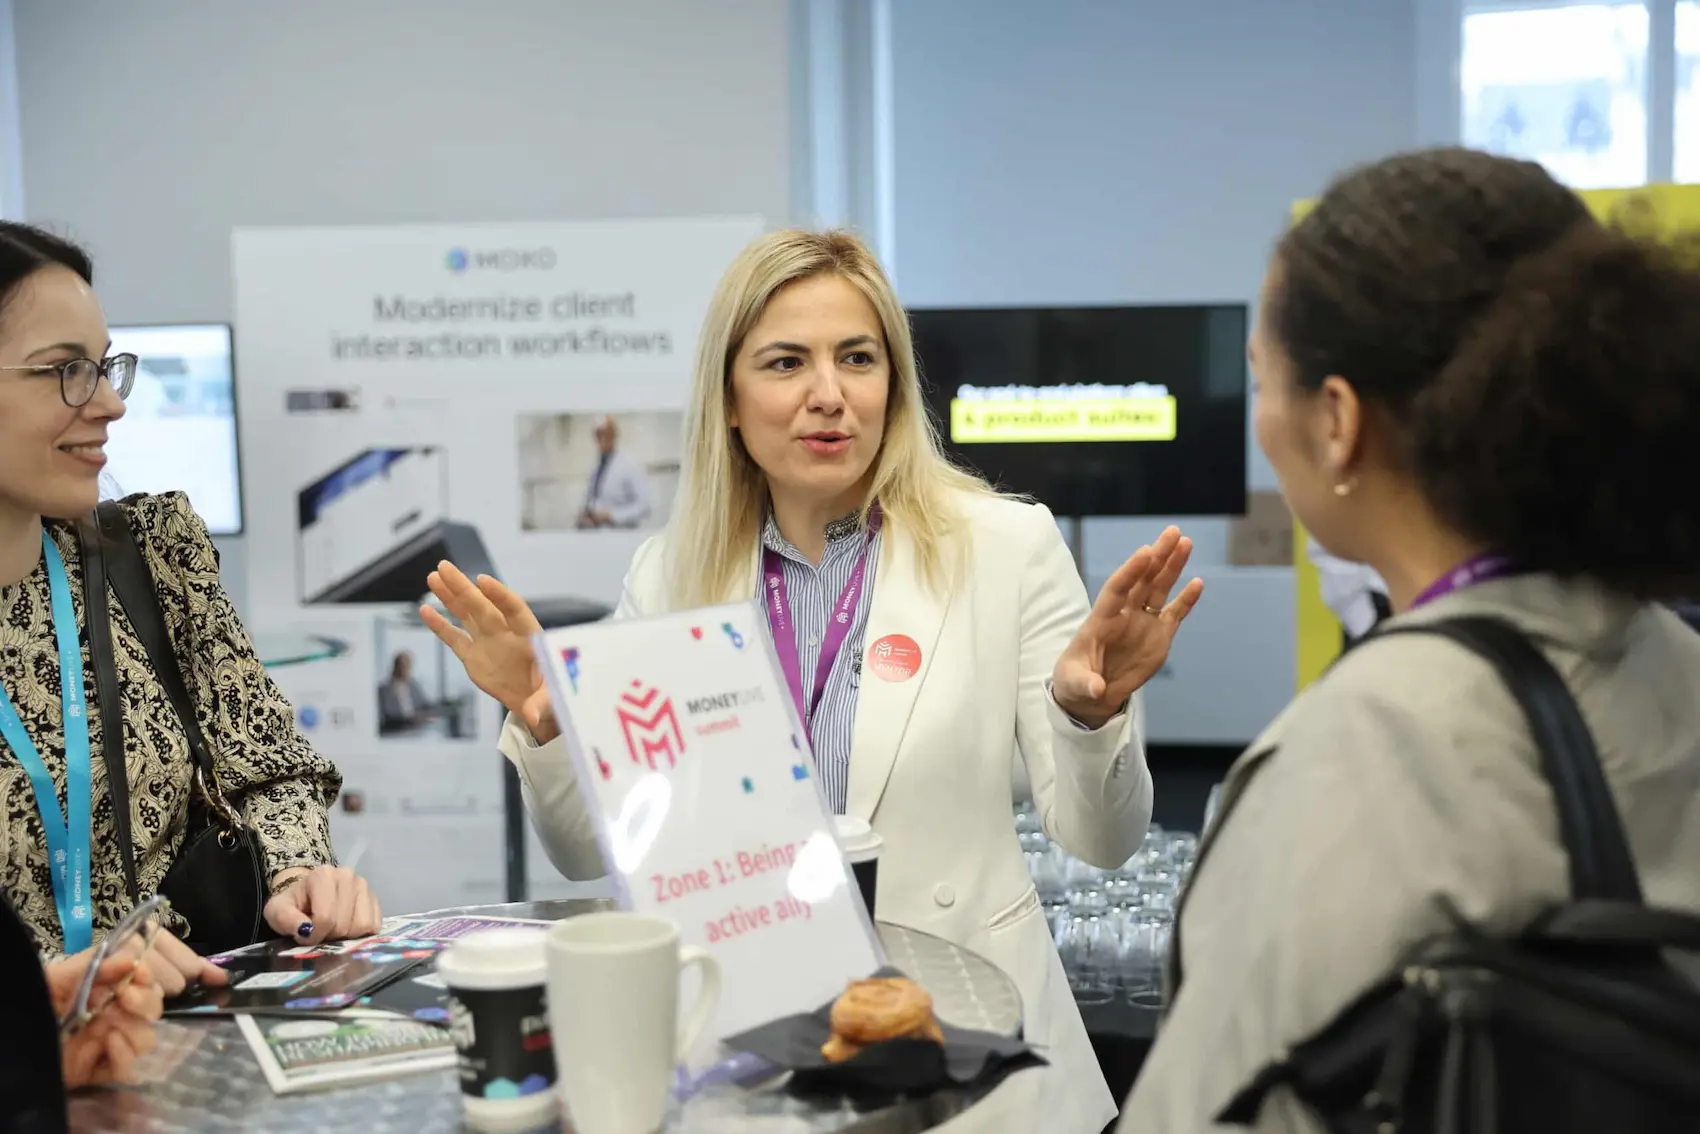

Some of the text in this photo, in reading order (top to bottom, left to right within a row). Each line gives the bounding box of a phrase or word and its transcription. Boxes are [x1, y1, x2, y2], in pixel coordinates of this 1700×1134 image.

[475, 249, 557, 271] MOKO
[372, 290, 635, 321] Modernize client
[333, 326, 672, 359] interaction workflows
[983, 408, 1079, 430] product
[695, 714, 742, 736] summit
[649, 869, 710, 903] Zone
[713, 860, 736, 885] 1:
[704, 904, 772, 943] active
